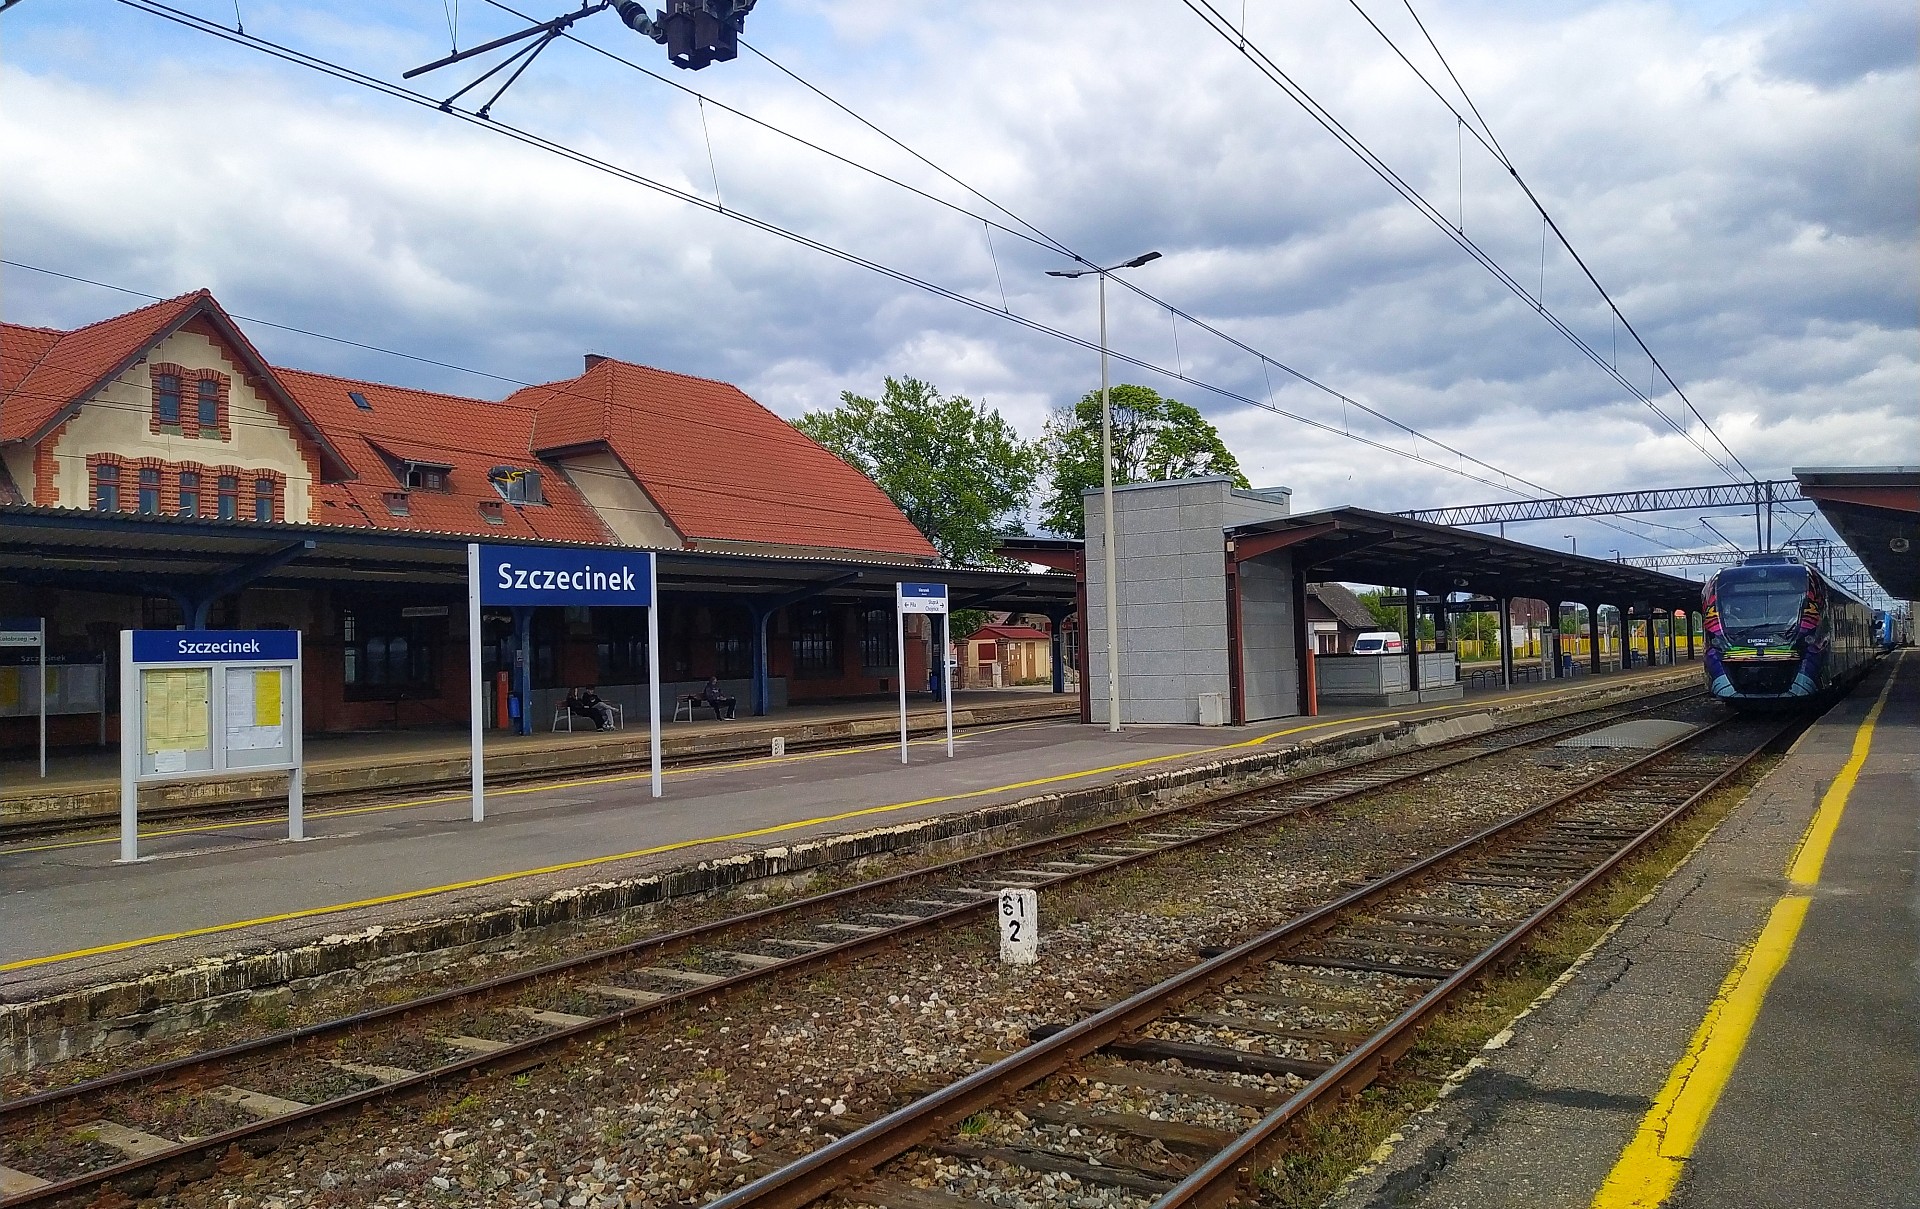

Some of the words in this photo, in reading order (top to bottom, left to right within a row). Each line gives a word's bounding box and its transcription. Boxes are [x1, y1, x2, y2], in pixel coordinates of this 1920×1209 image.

[498, 563, 635, 591] Szczecinek
[178, 639, 260, 653] Szczecinek
[1009, 920, 1021, 942] 2
